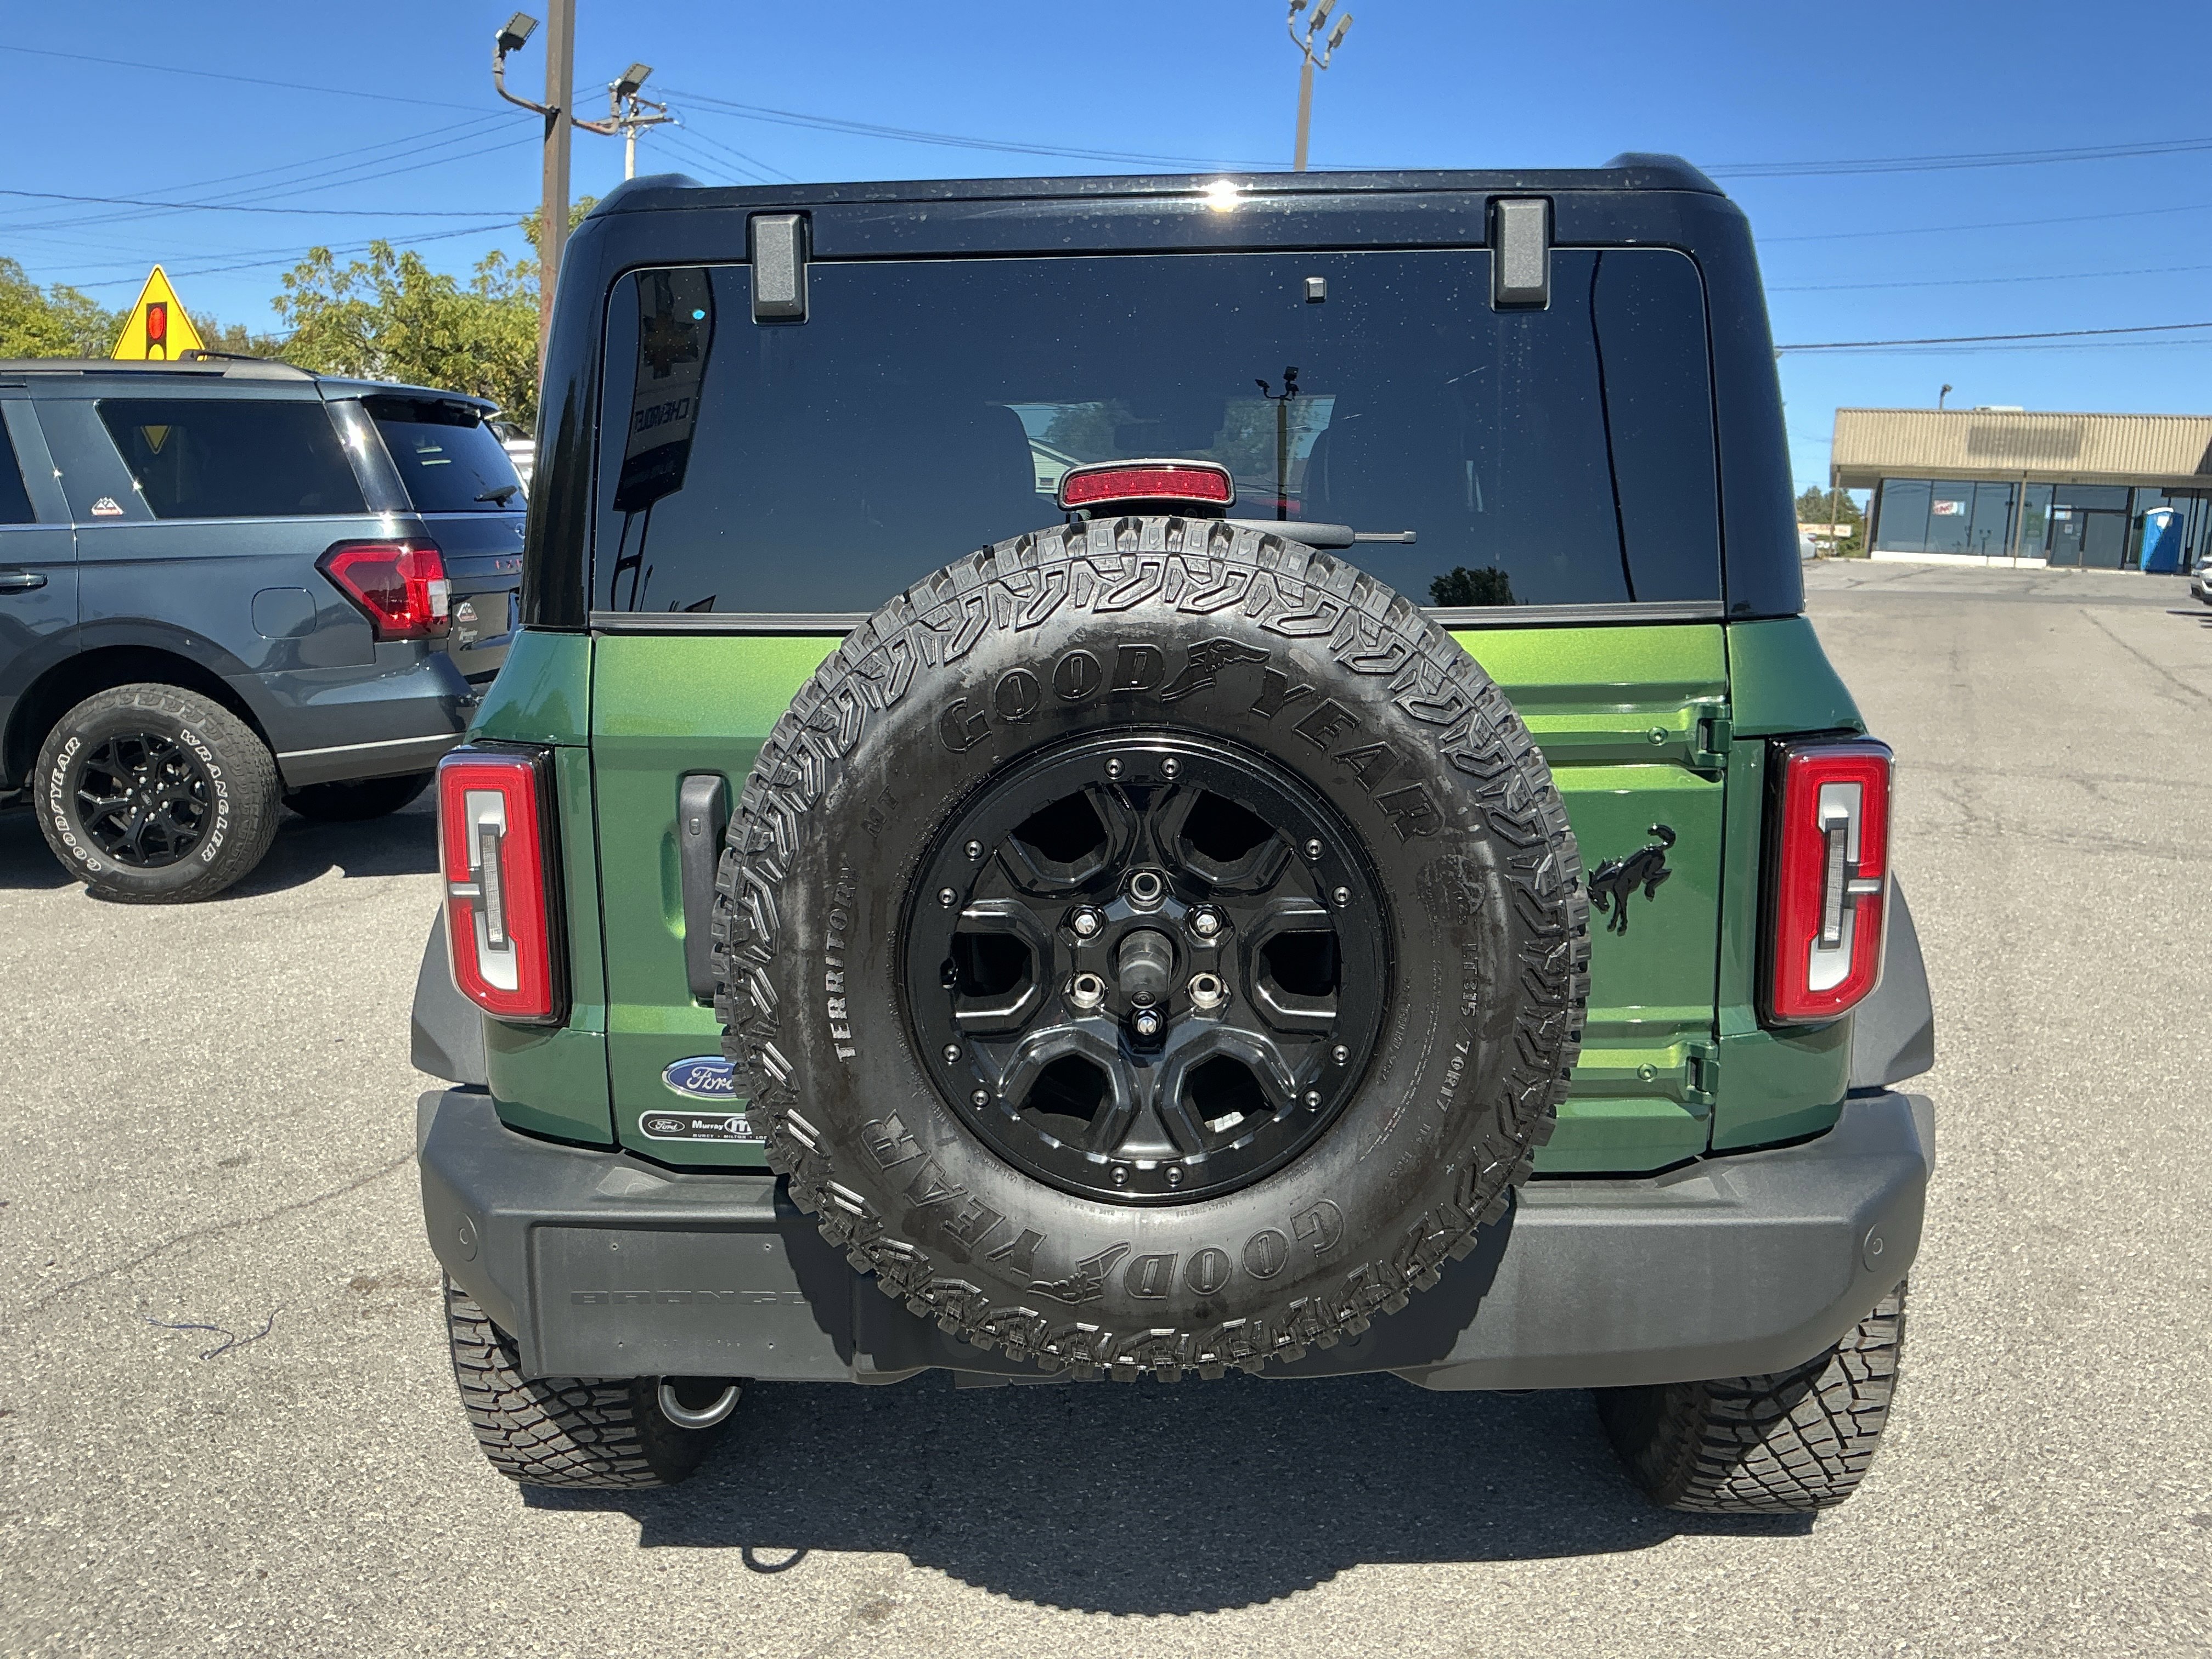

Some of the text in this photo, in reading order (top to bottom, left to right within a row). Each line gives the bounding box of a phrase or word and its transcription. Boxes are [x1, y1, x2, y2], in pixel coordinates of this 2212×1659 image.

[50, 736, 101, 872] GOODYEAR
[180, 729, 229, 862] WRANGLER
[825, 854, 860, 1063] TERRITORY
[654, 1120, 678, 1131] Ford
[692, 1120, 724, 1131] Murray
